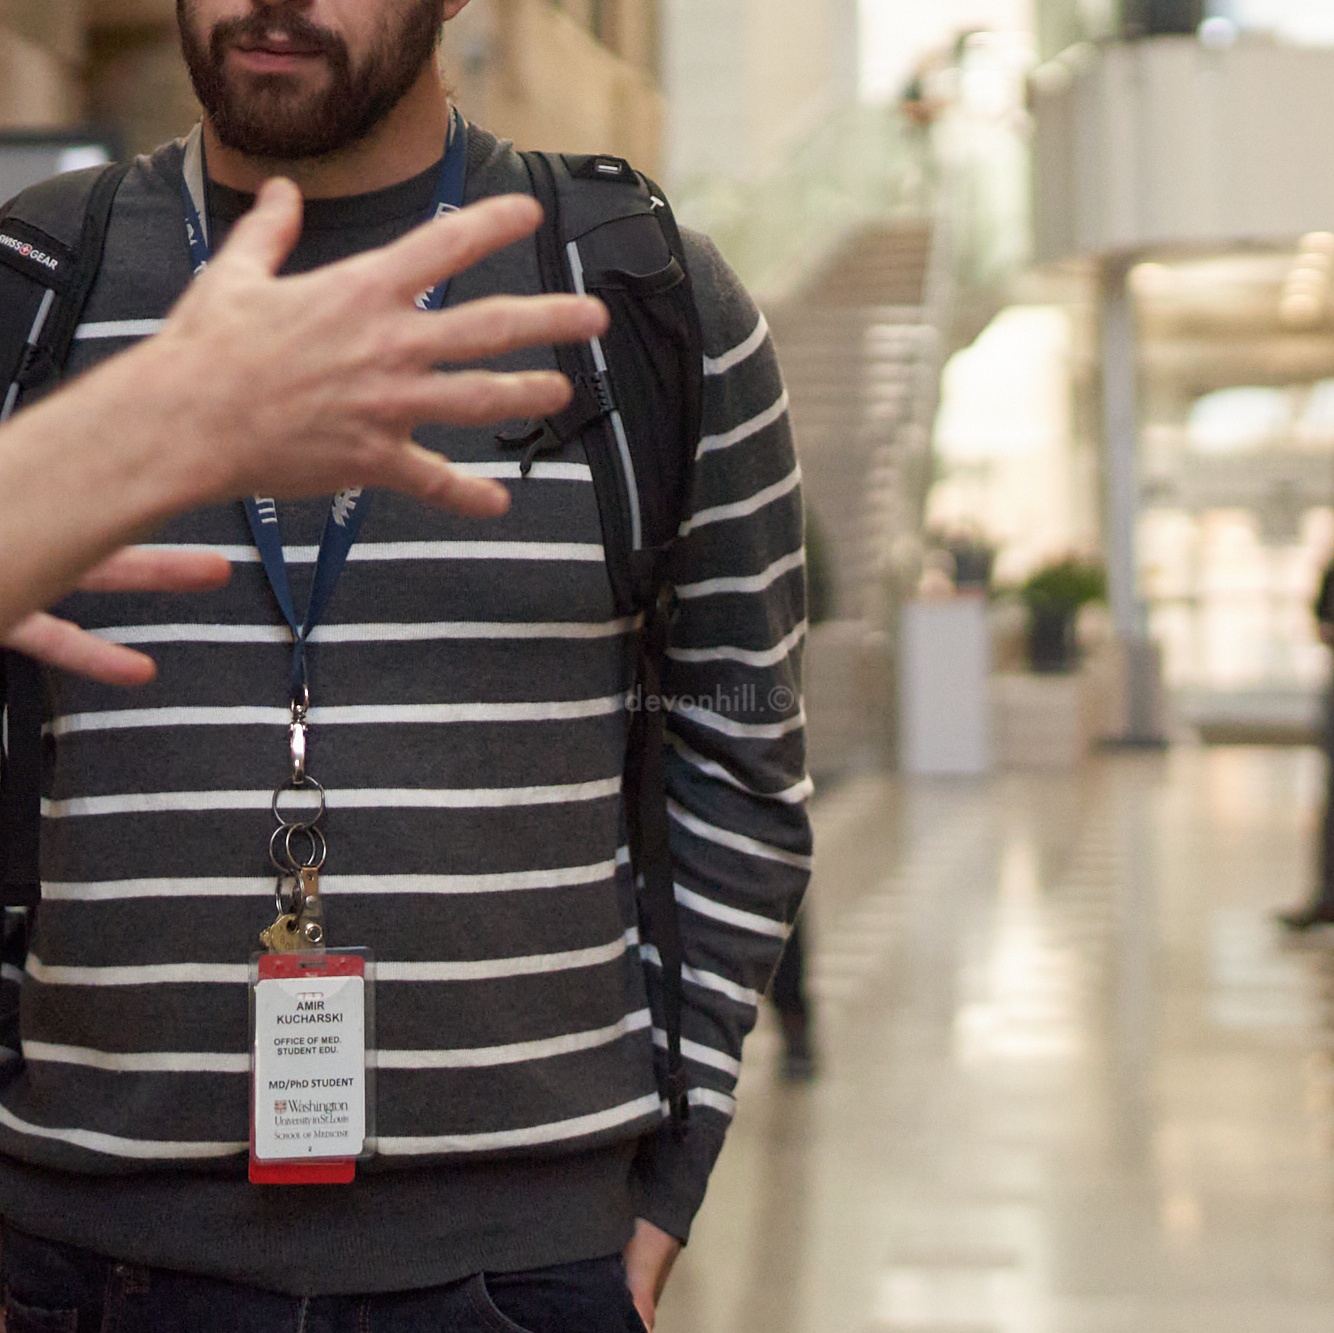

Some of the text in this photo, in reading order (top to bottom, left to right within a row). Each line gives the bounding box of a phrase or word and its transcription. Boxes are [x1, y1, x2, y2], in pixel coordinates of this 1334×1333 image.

[30, 249, 59, 271] GEAR
[296, 1000, 325, 1011] AMIR
[276, 1013, 343, 1025] KUCHARSKI
[273, 1036, 342, 1046] OFFICE OF MED.
[277, 1046, 339, 1056] STUDENT EDU.
[268, 1077, 354, 1091] MD/PhD STUDENT
[288, 1099, 348, 1114] Washington
[274, 1115, 311, 1126] University
